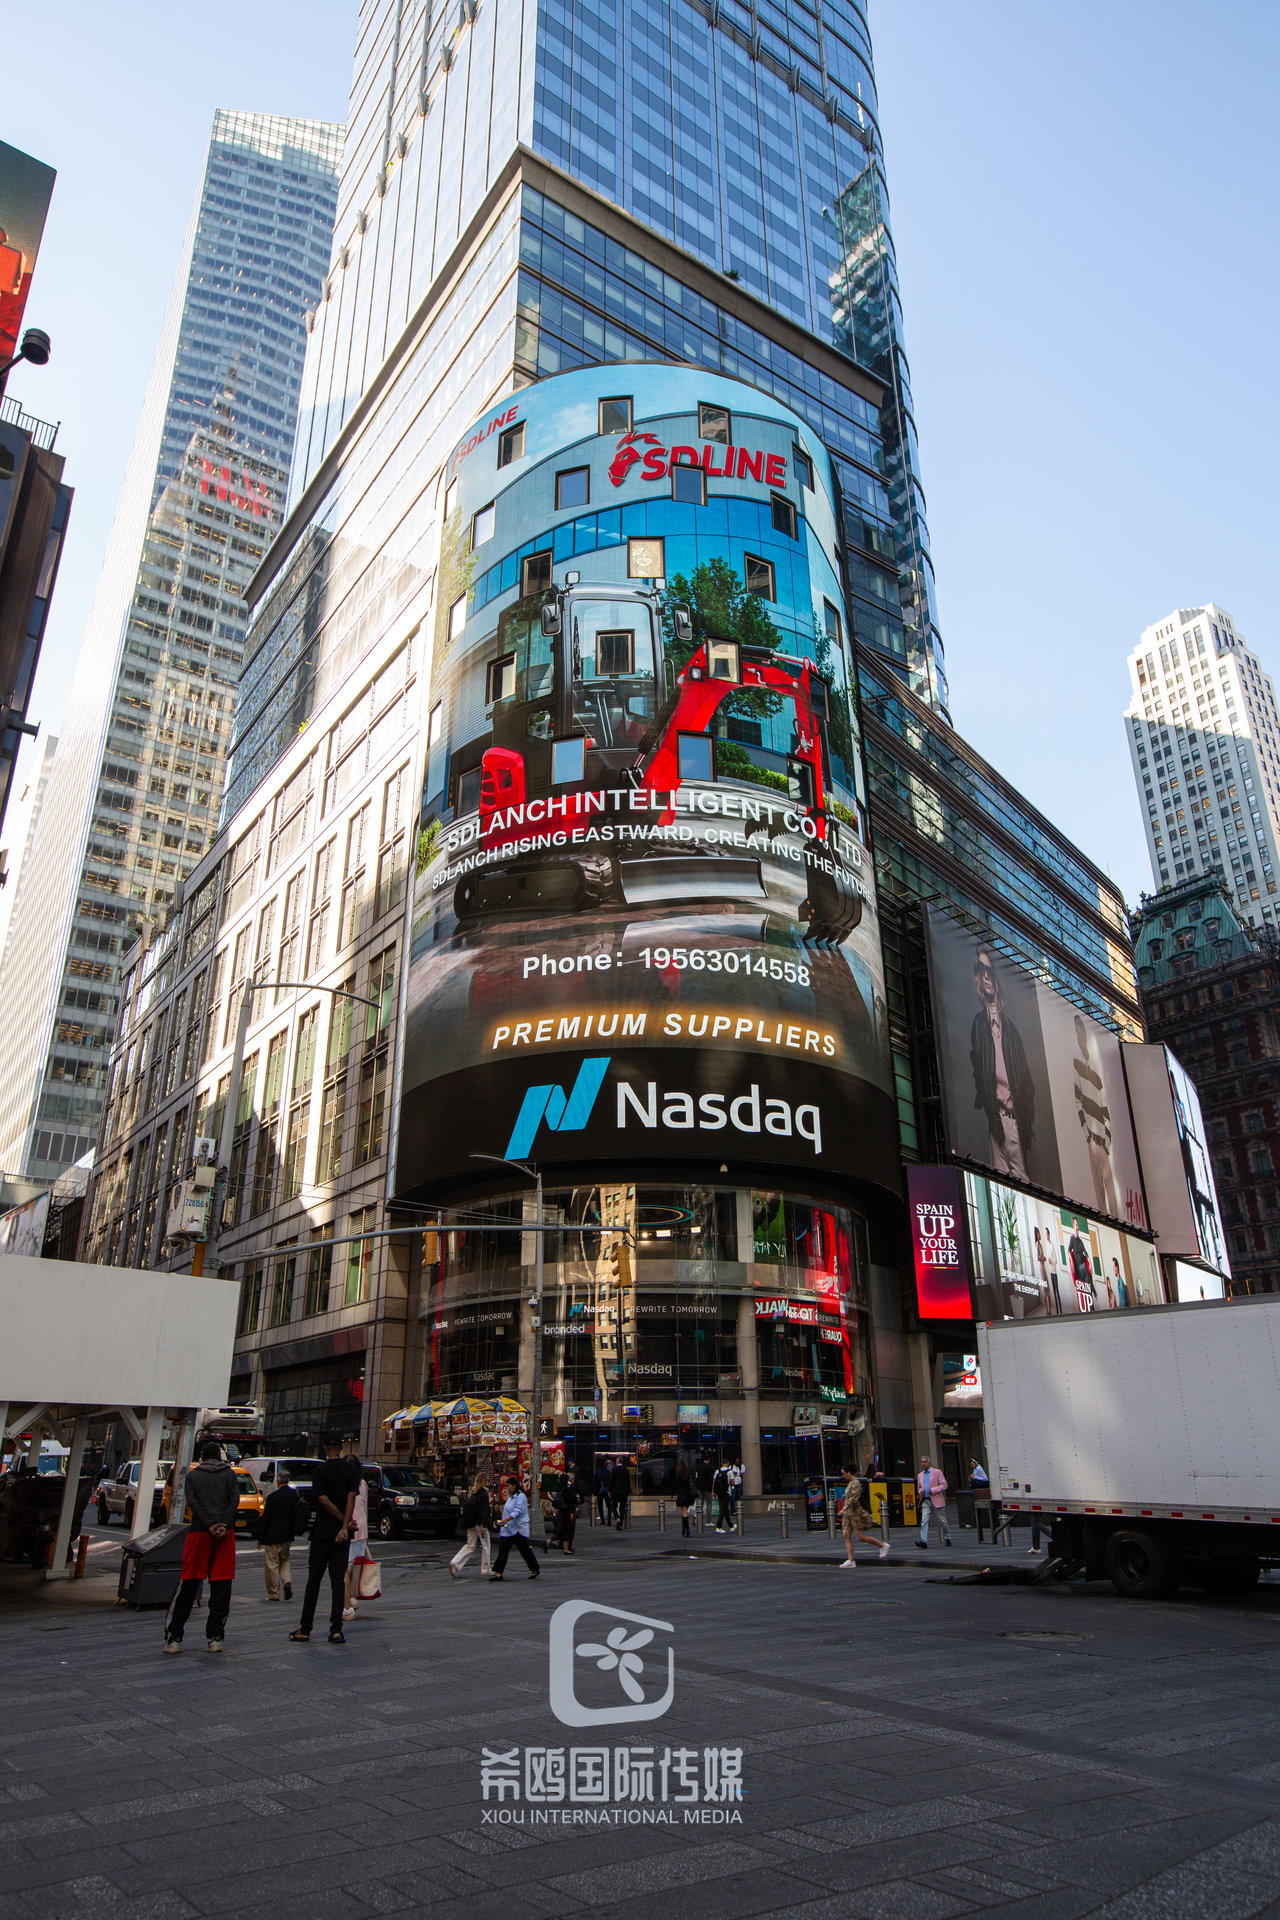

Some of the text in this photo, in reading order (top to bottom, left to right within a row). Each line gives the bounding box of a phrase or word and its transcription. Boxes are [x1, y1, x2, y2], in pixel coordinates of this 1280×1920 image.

[640, 444, 787, 488] SDLINE
[447, 795, 567, 852] SDLANCH
[575, 789, 778, 825] INTELLIGENT
[832, 830, 862, 867] LTD
[431, 824, 873, 906] SDLANCH RISING EASTWARD, CREATING THE FUTURE
[638, 947, 811, 987] 19563014558
[492, 1013, 836, 1056] PREMIUM SUPPLIERS
[616, 1081, 823, 1155] Nasdaq
[916, 1203, 953, 1216] SPAIN
[917, 1216, 955, 1238] UP
[920, 1238, 957, 1250] YOUR
[921, 1250, 959, 1265] LIFE
[1075, 1279, 1092, 1292] SPAIN
[584, 1305, 718, 1314] Nasdaq REWRITE TOMORROW
[1076, 1291, 1093, 1312] UP
[454, 1316, 475, 1326] REWRITE
[477, 1312, 513, 1322] TOMORROW
[628, 1363, 672, 1376] Nasdaq
[783, 1367, 804, 1380] Nasdaq
